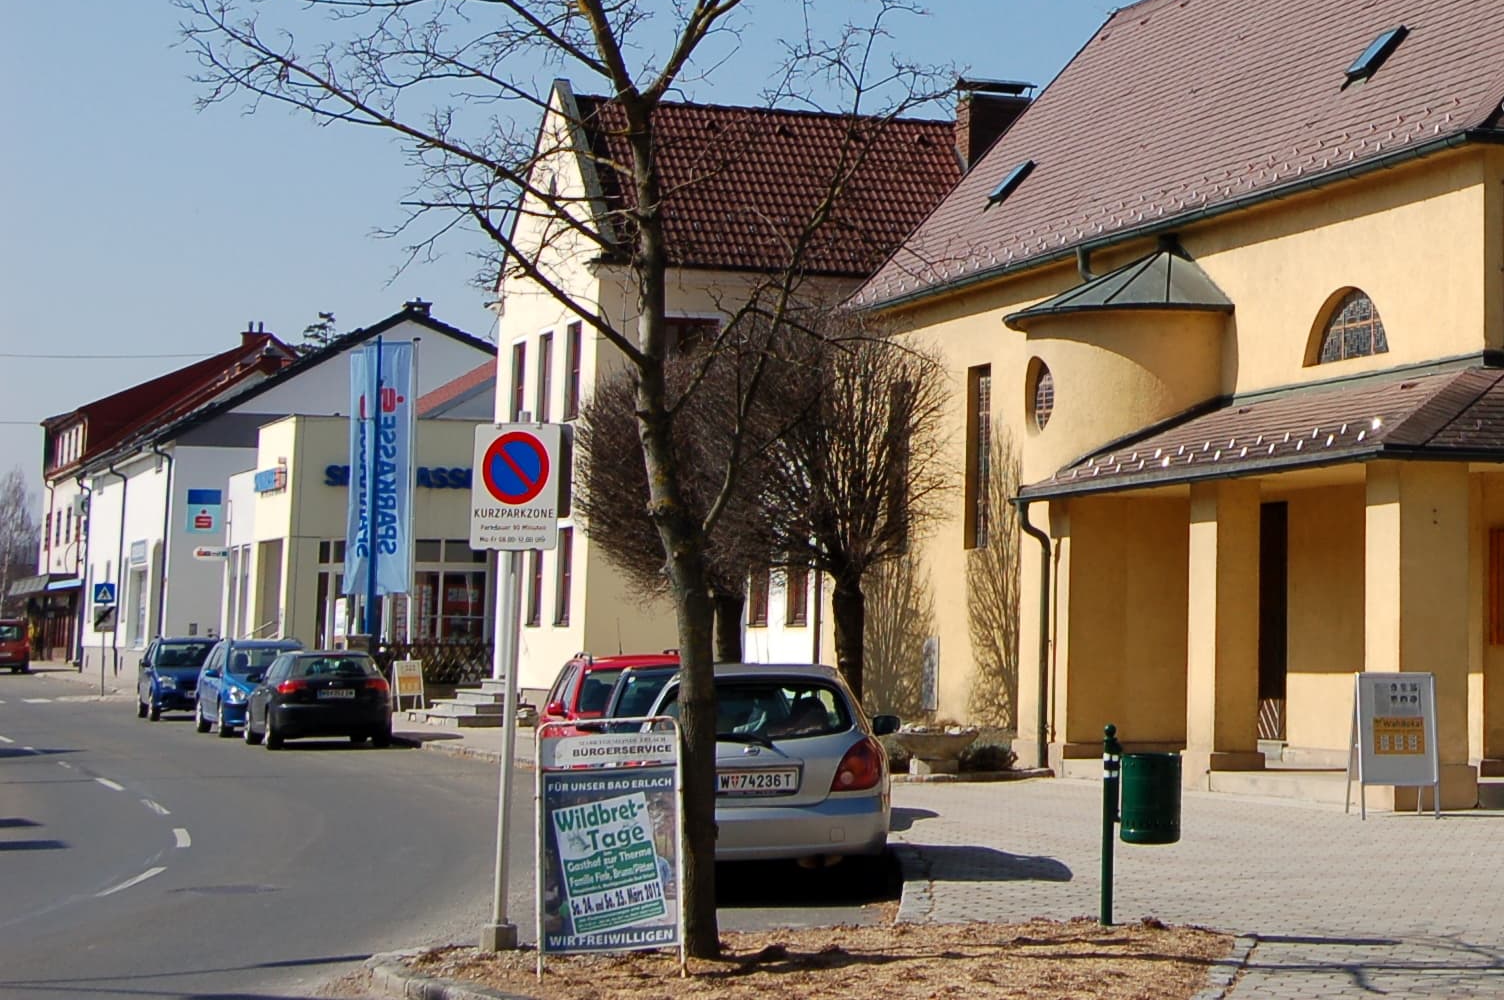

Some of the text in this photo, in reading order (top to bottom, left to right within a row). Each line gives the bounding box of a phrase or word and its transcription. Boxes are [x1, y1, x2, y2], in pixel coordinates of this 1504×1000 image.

[474, 508, 553, 519] KURZPARKZONE
[572, 744, 673, 757] BÜRGERSERVICE
[548, 778, 672, 792] FÜR UNSER BAD ERLACH
[554, 799, 645, 832] Wildbret-
[586, 823, 645, 850] Tage
[567, 857, 601, 872] Gasthof
[619, 848, 652, 861] Therme
[627, 887, 645, 904] März
[644, 881, 661, 900] 2012
[549, 929, 674, 947] WIR FREIWILLIGEN
